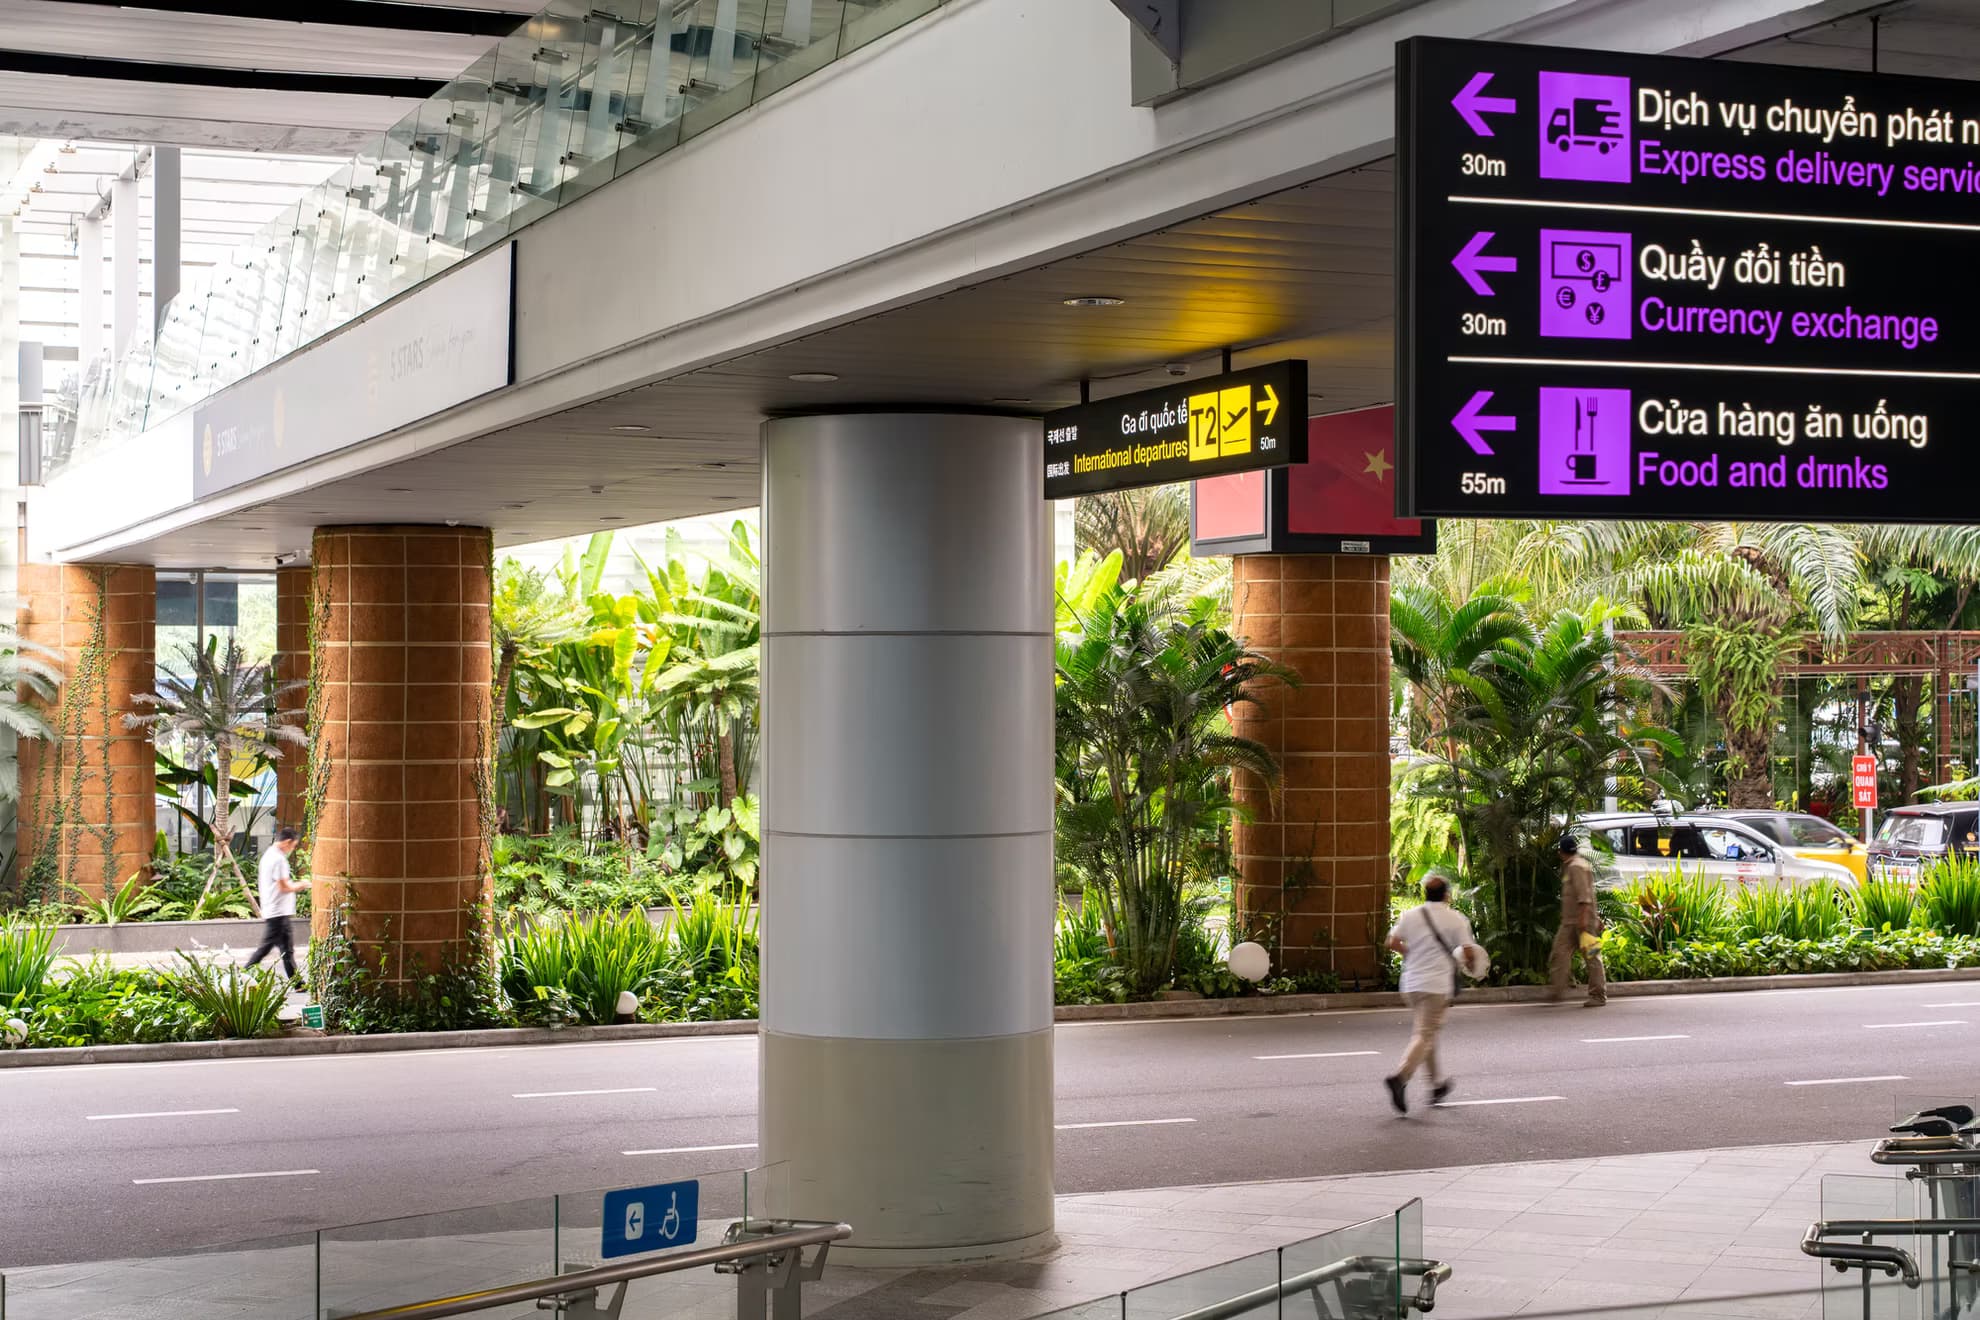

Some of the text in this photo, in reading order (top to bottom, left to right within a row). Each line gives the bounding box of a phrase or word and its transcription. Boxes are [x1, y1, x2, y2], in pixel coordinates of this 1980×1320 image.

[1638, 87, 1709, 131] Dịch
[1718, 101, 1757, 136] vụ
[1766, 95, 1877, 144] chuyển
[1887, 107, 1954, 148] phát
[1461, 154, 1507, 177] 30m
[1639, 139, 1766, 184] Express
[1775, 149, 1895, 197] delivery
[1639, 238, 1846, 291] Quầy đổi tiền
[1461, 314, 1507, 336] 30m
[1639, 296, 1939, 350] Currency exchange
[1121, 397, 1188, 435] Ga đi quốc tế
[1190, 405, 1217, 448] T2
[1638, 398, 1929, 449] Cửa hàng ăn uống
[1074, 439, 1188, 474] International departures
[1260, 437, 1276, 451] 50m
[1460, 473, 1507, 496] 55m
[1637, 451, 1889, 489] Food and drinks
